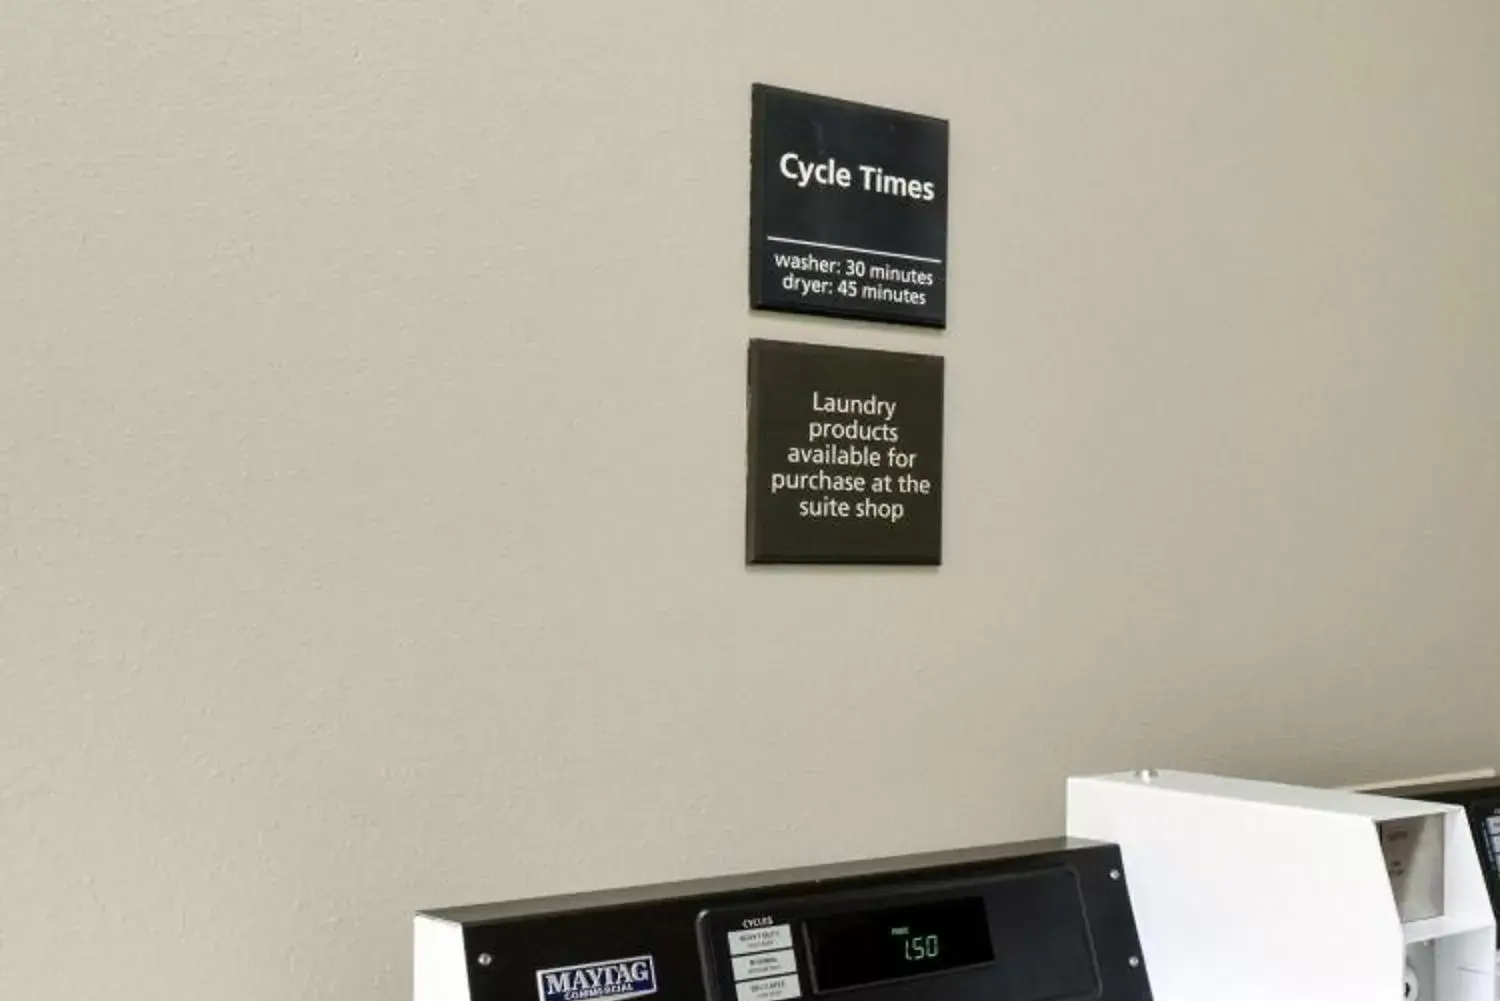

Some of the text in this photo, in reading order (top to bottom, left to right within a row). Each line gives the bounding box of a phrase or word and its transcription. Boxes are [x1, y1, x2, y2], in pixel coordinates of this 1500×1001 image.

[779, 153, 936, 201] Cycle Times
[774, 252, 934, 286] washer: 30 minutes
[782, 273, 927, 306] dryer: 45 minutes
[812, 391, 897, 421] Laundry
[809, 419, 899, 442] products
[787, 444, 918, 468] available for
[771, 469, 931, 495] purchase at the
[799, 496, 905, 523] suite shop
[545, 961, 649, 995] MAYTAG
